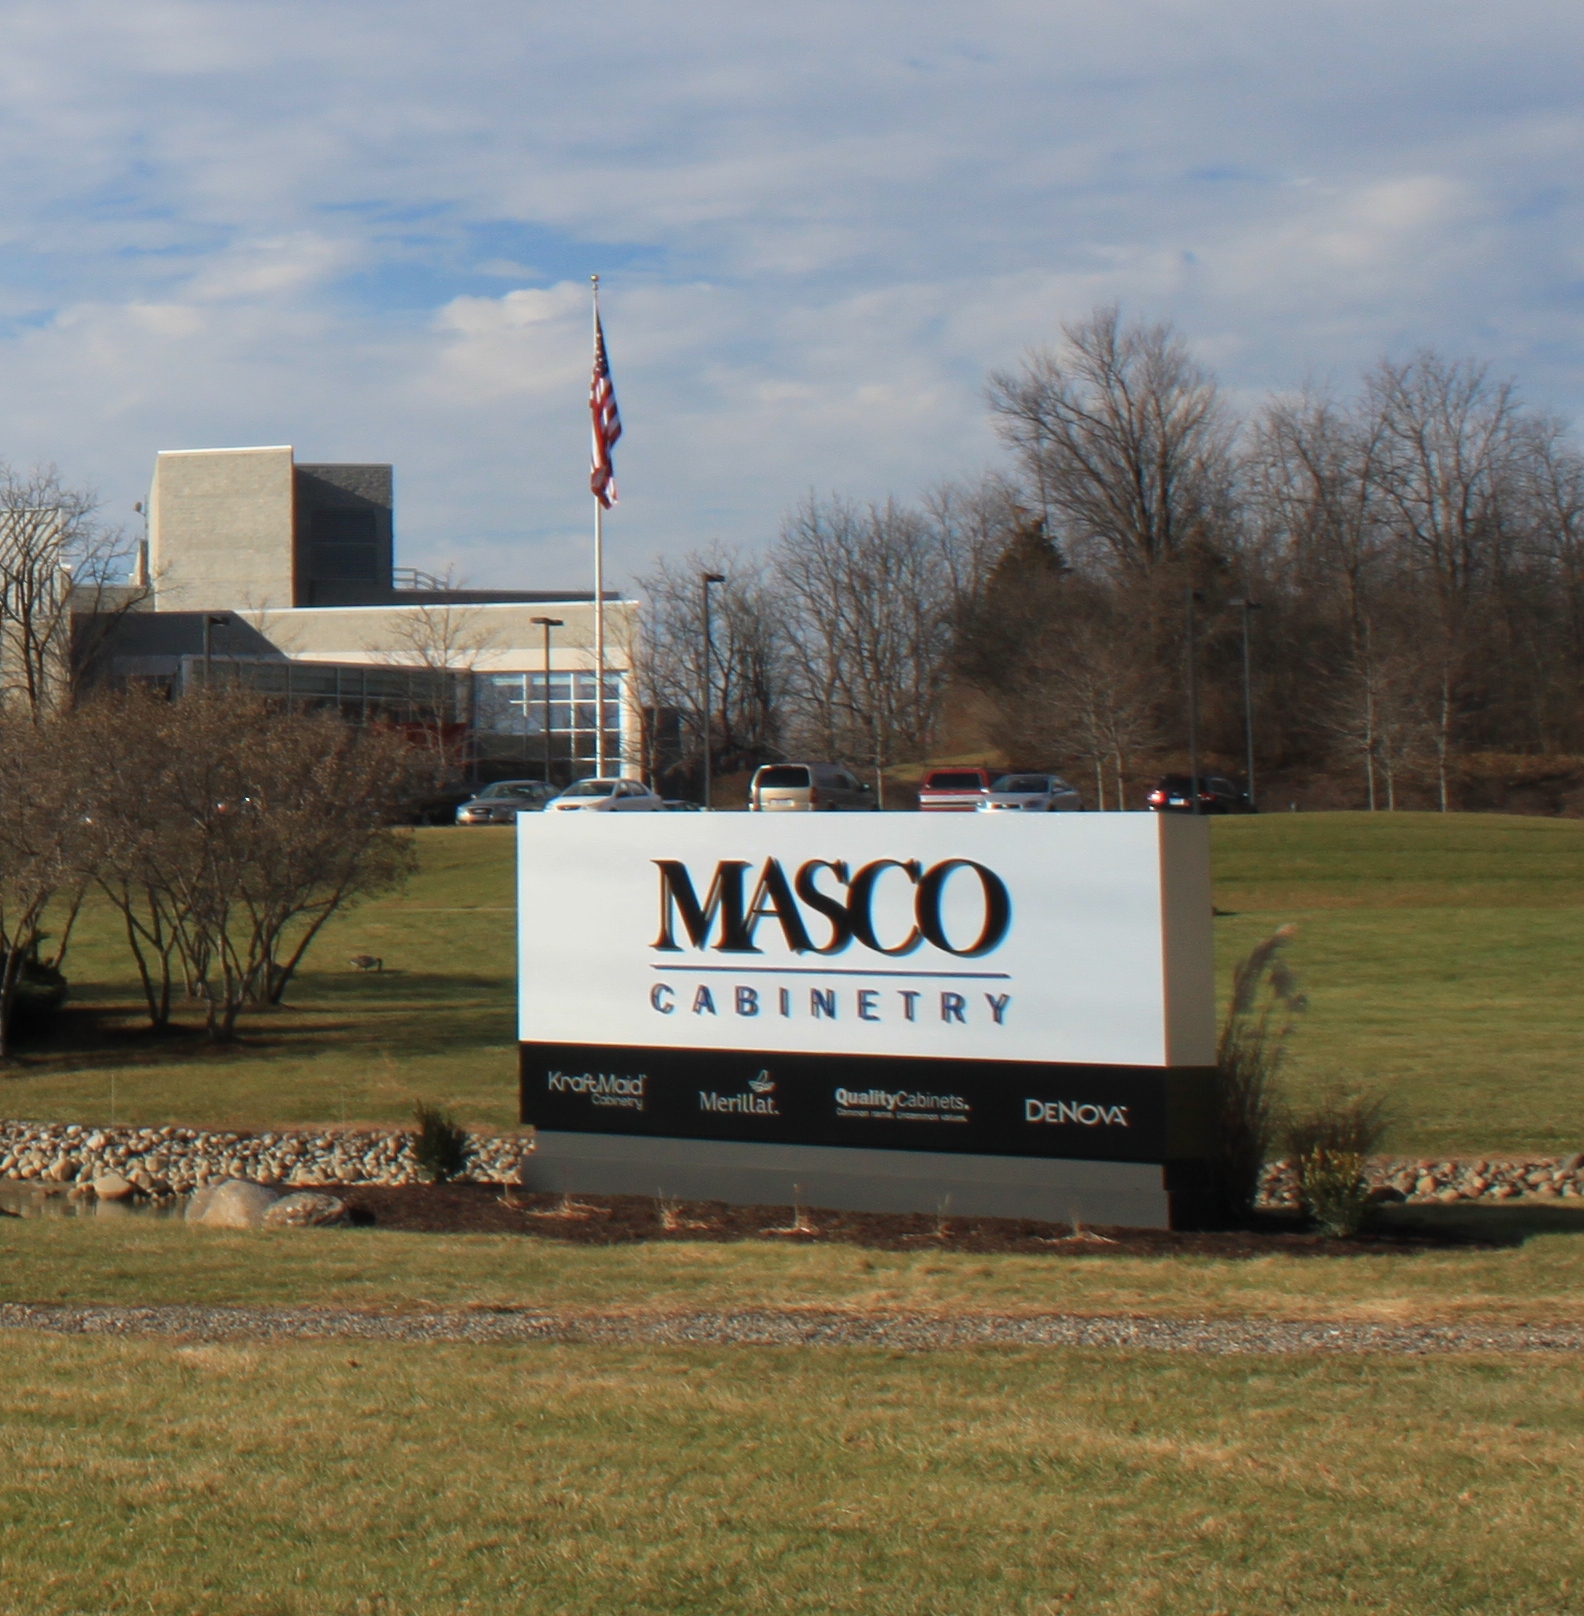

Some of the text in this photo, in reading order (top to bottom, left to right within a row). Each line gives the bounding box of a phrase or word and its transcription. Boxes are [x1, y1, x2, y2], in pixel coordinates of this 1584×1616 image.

[649, 856, 1012, 959] MASCO
[649, 982, 1012, 1026] CABINETRY
[590, 1092, 644, 1112] Cabinetry
